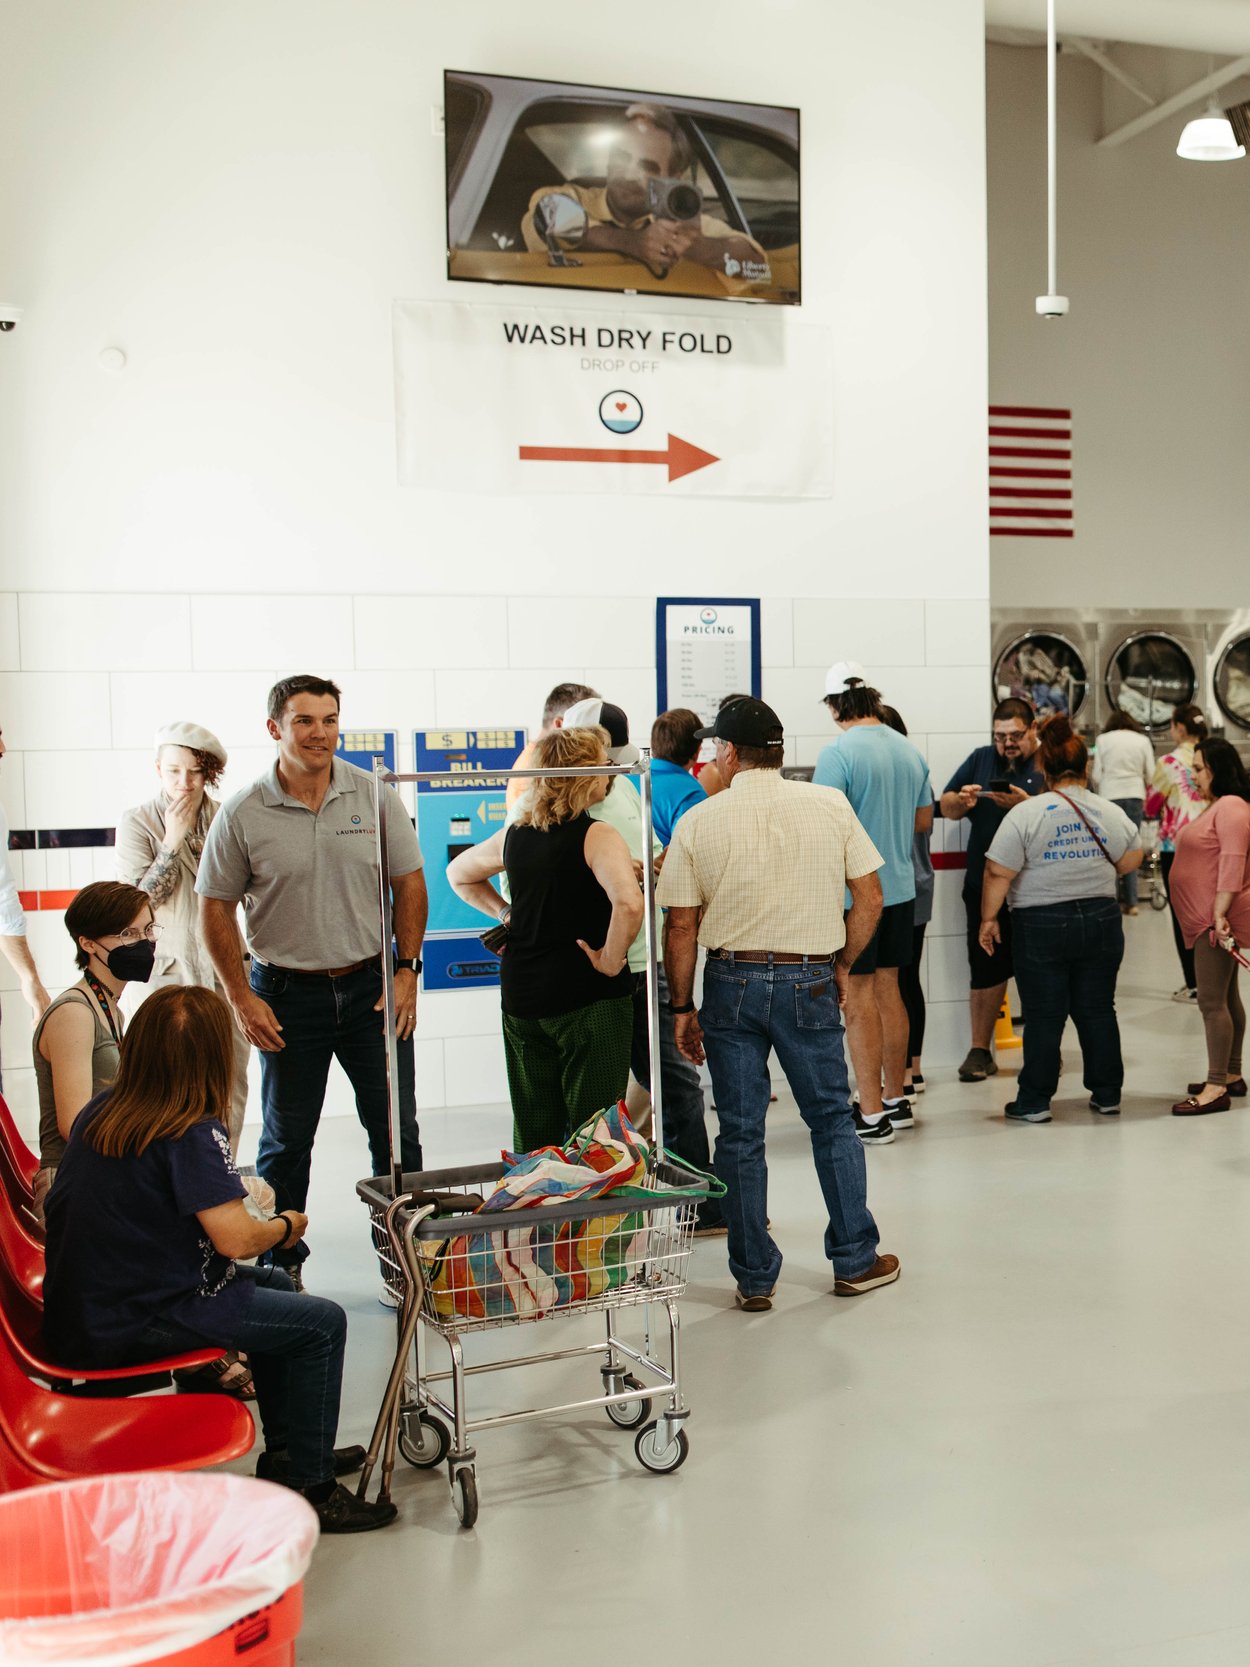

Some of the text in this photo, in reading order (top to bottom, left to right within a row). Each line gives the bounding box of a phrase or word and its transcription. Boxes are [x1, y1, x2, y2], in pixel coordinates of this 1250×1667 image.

[503, 322, 733, 354] WASH DRY FOLD
[580, 357, 660, 373] DROP OFF
[683, 625, 735, 635] PRICING
[450, 762, 485, 771] BILL
[430, 779, 507, 788] BREAKER
[1056, 822, 1082, 837] JOIN
[1048, 836, 1108, 848] CREDIT UNN
[1044, 848, 1109, 860] REVOLUTIO
